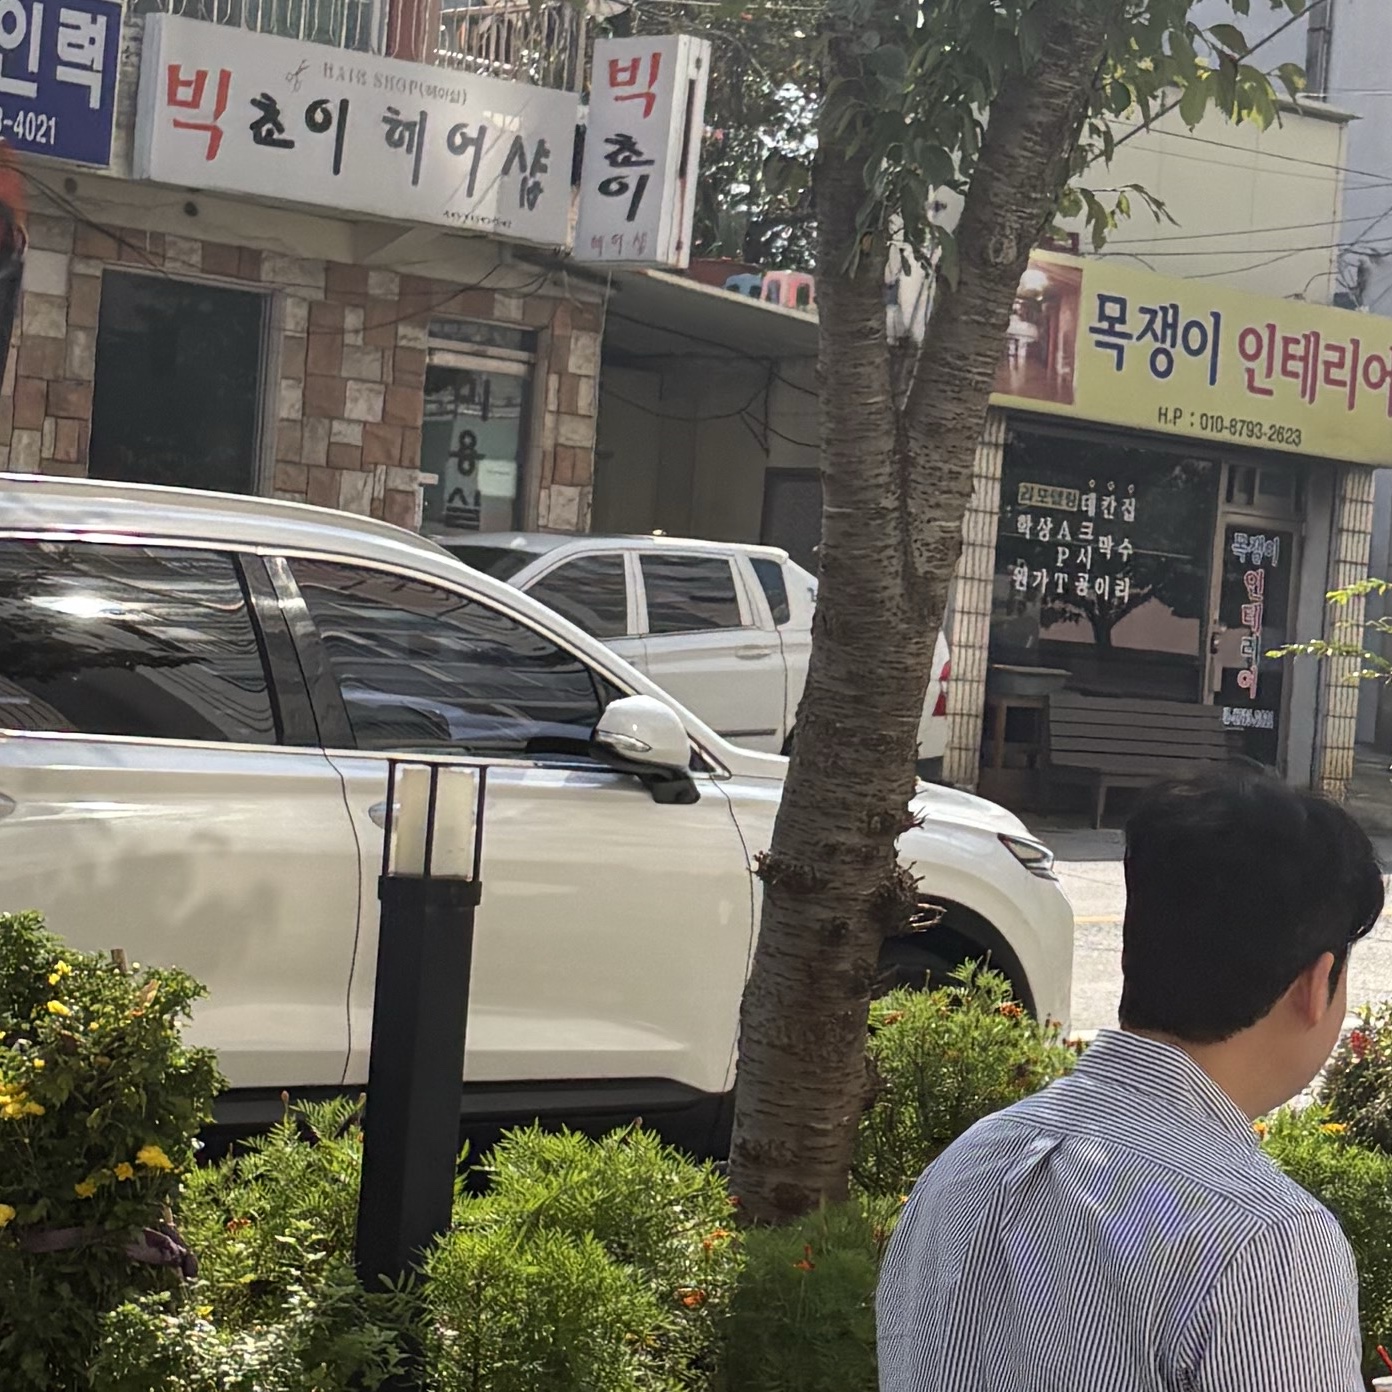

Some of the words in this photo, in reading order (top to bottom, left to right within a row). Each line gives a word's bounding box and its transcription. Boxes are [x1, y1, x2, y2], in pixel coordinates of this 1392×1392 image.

[0, 0, 107, 109] 인력
[0, 106, 56, 145] -4021
[382, 106, 551, 212] 헤어샵
[1088, 292, 1222, 387] 목쟁이
[1199, 412, 1303, 447] 010-8793-2623
[1231, 532, 1280, 567] 목쟁이
[1237, 568, 1265, 699] 인테리어
